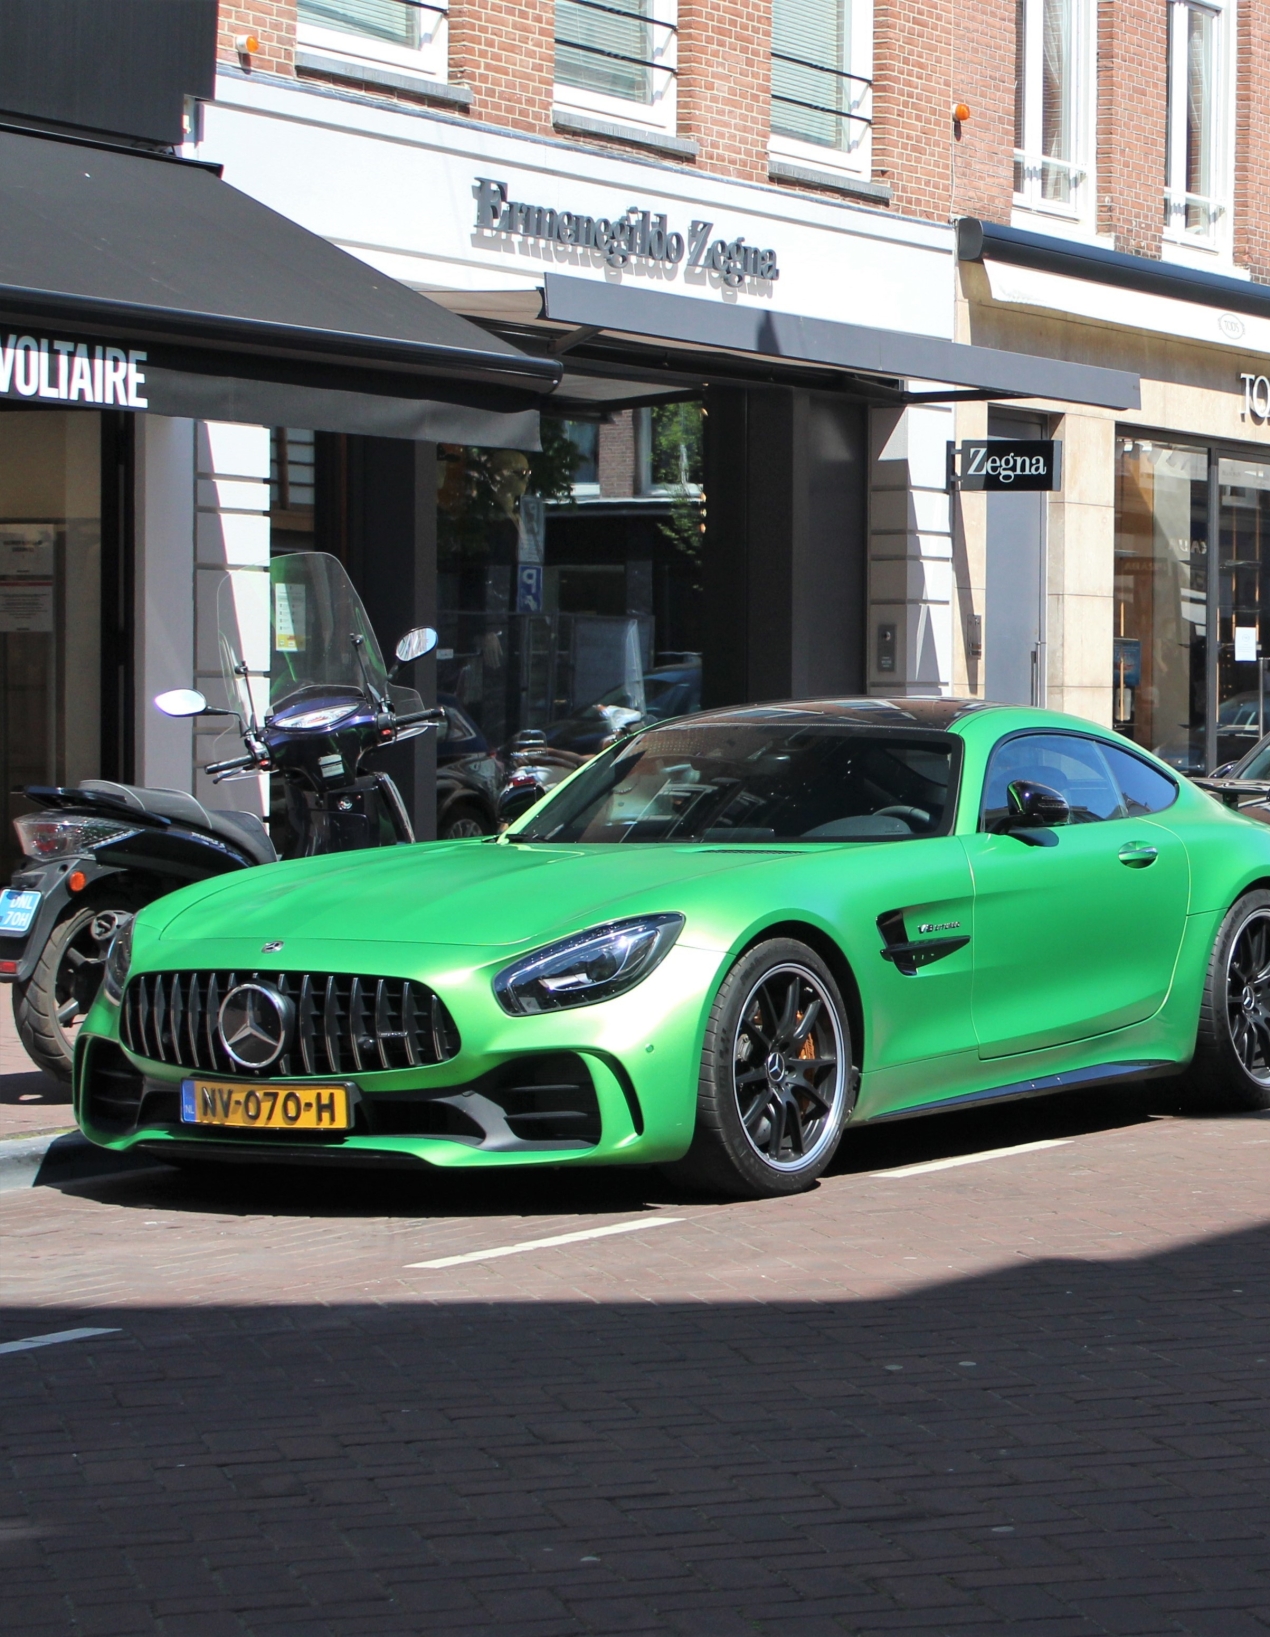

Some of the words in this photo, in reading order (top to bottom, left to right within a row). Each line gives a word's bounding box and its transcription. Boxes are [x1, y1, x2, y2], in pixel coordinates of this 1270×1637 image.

[473, 177, 685, 268] Ermenegildo
[687, 220, 780, 287] Zegna
[0, 334, 149, 409] VOLTAIRE
[967, 447, 1047, 483] Zegna
[201, 1086, 336, 1127] NV-070-H
